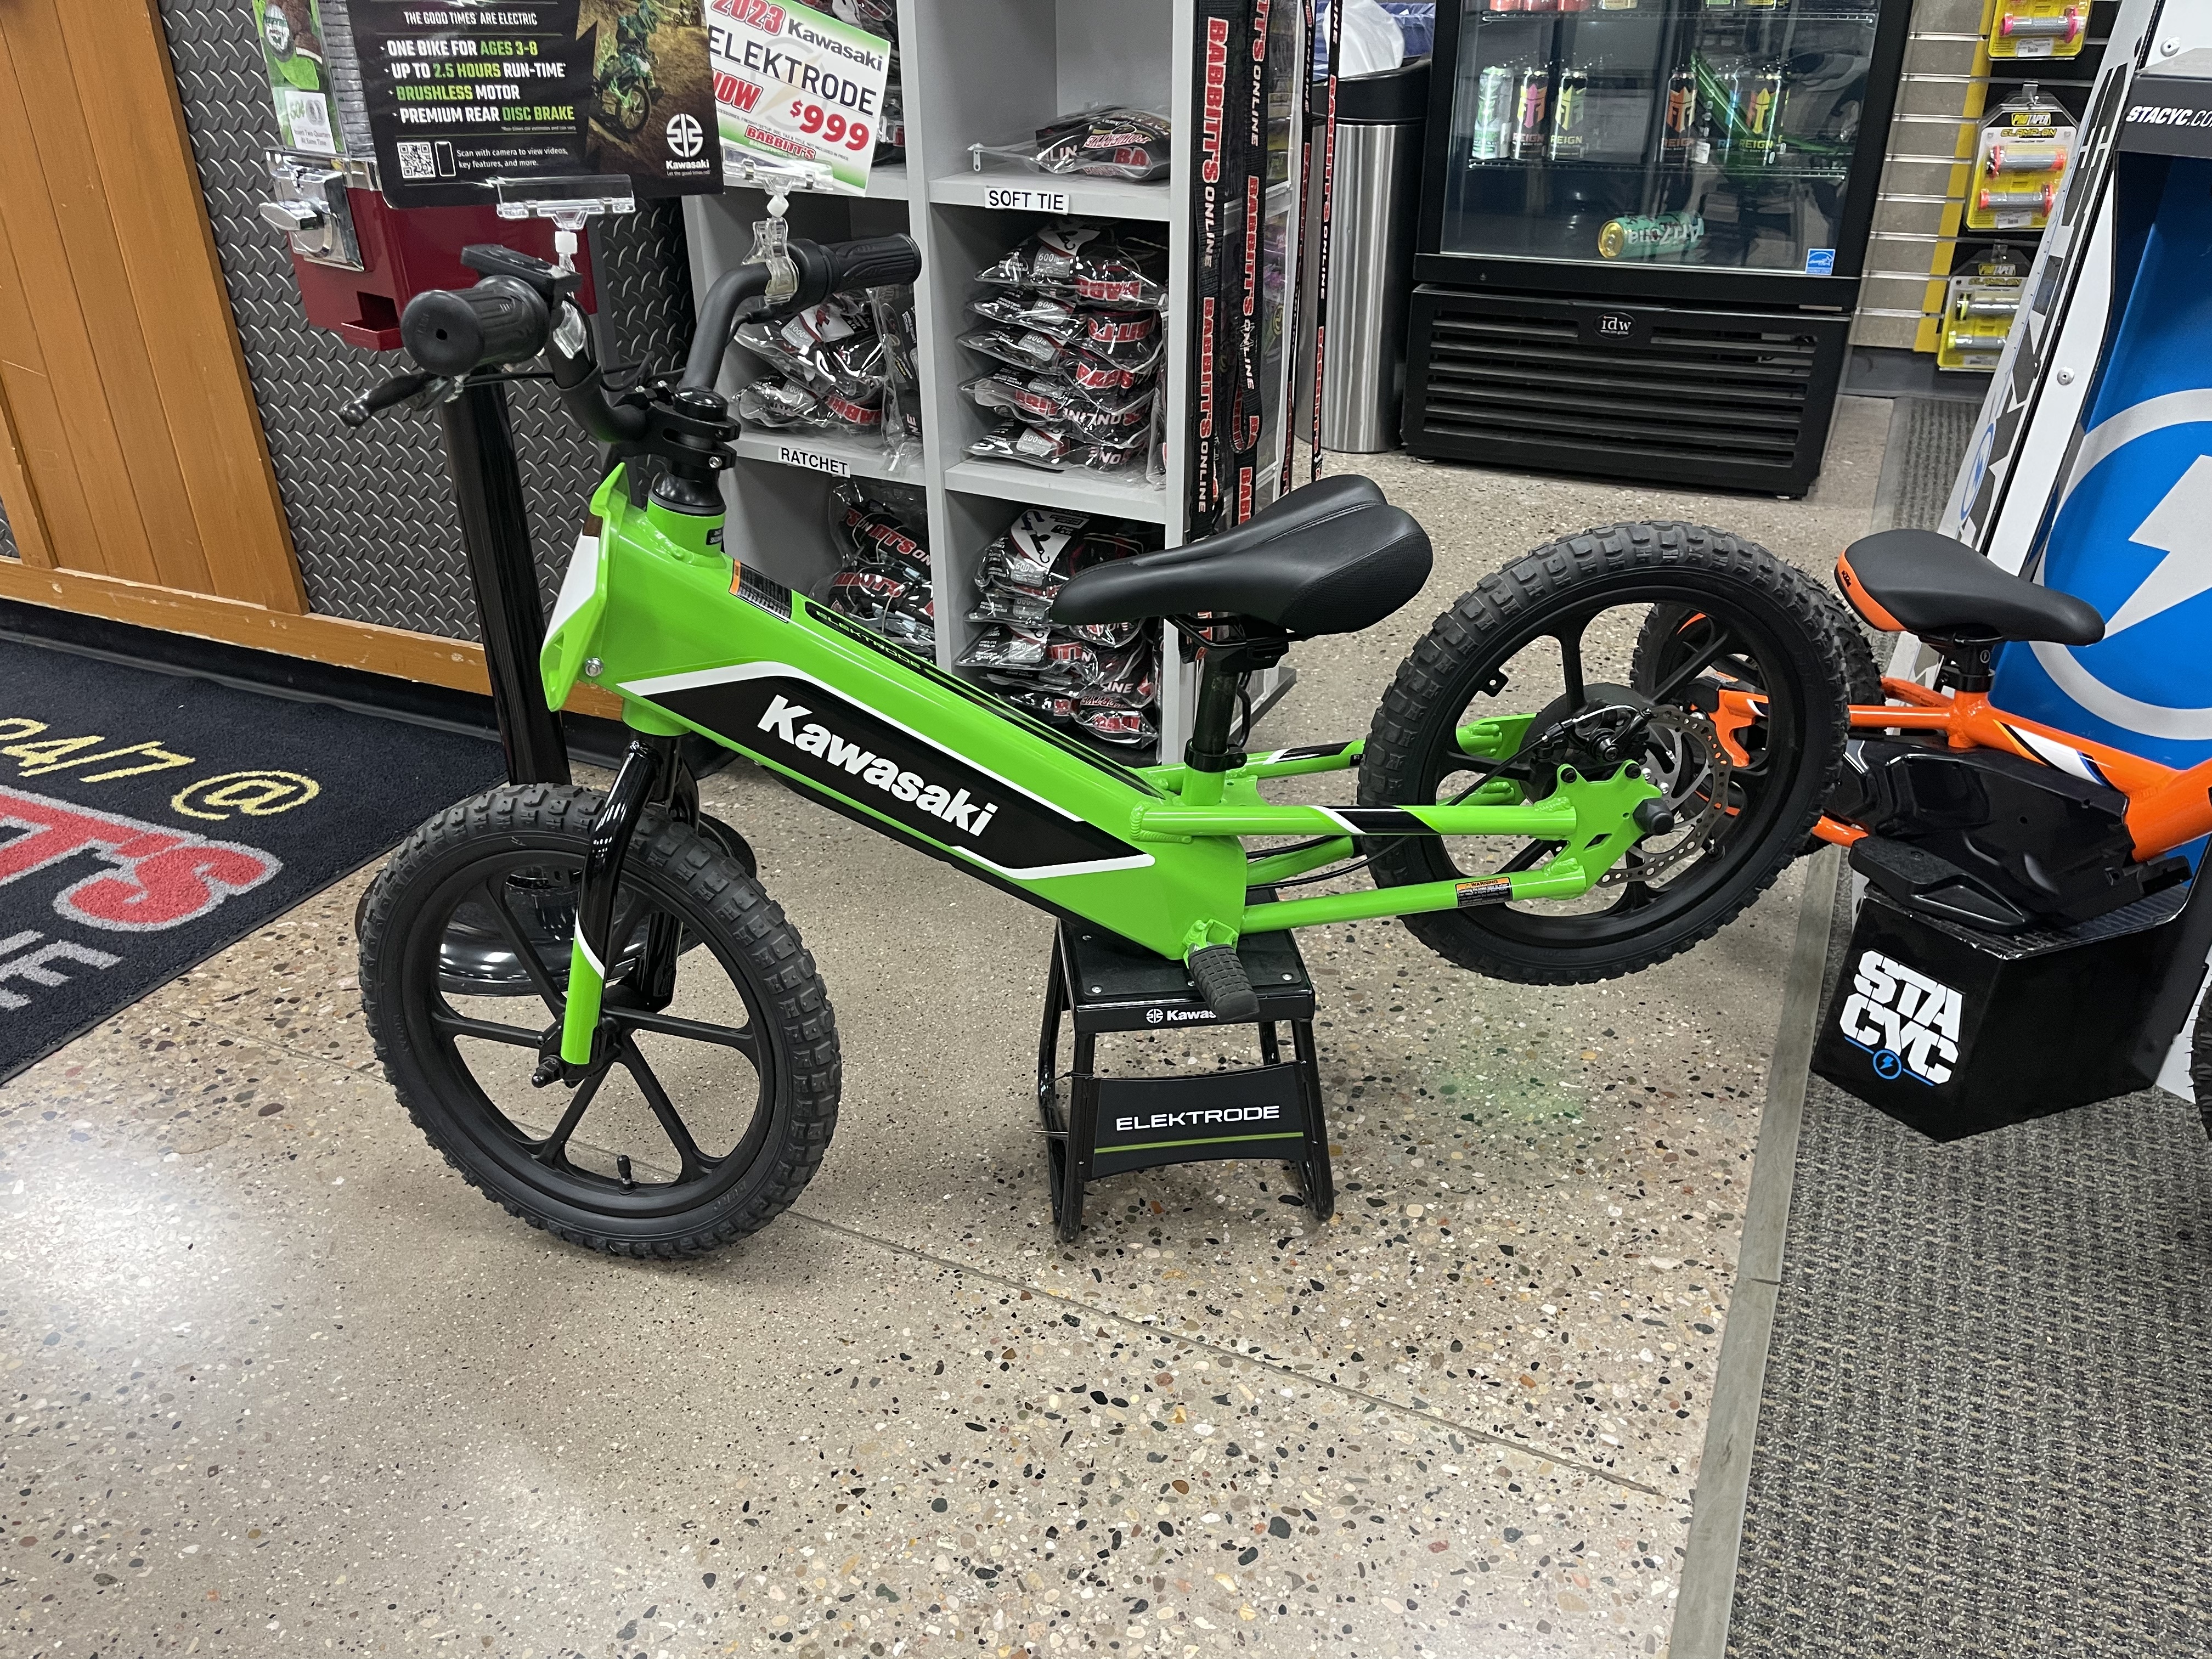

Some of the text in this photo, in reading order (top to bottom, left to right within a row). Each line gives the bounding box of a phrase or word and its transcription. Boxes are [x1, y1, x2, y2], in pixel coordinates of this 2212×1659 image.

[404, 12, 422, 24] THE
[424, 12, 448, 24] GOOD
[481, 12, 496, 25] ARE
[499, 13, 538, 25] ELECTRIC
[387, 40, 539, 56] ONE BIKE FOR AGES 3-8
[788, 18, 883, 72] Kawasaki
[391, 63, 410, 78] UP
[411, 63, 431, 78] TO
[433, 63, 454, 78] 2.5
[457, 63, 501, 78] HOURS
[708, 24, 877, 116] ELEKTRODE
[396, 85, 520, 101] BRUSHLESS MOTOR
[399, 106, 575, 123] PREMIUM REAR DISC BRAKE
[1251, 65, 1261, 147] ONLINE
[2126, 106, 2212, 127] STACYC.CO
[790, 99, 870, 151] $999
[744, 125, 816, 160] BABBITT'S
[1203, 16, 1229, 268] BABBITT'S ONLINE
[1550, 136, 1583, 144] REIGN
[1739, 140, 1773, 149] REIGN
[476, 149, 491, 157] with
[544, 146, 568, 155] videos,
[459, 160, 471, 170] key
[473, 160, 503, 168] features,
[666, 159, 709, 170] Kawasaki
[989, 189, 1064, 211] SOFT TIE
[1243, 175, 1259, 316] BABBITT'S
[1601, 315, 1632, 330] idw
[1026, 334, 1047, 346] 600lb
[1198, 297, 1215, 513] BABBITT'S ONLINE
[1023, 435, 1043, 444] 600lb
[781, 447, 848, 476] RATCHET
[1015, 562, 1035, 573] 600lb
[816, 611, 921, 669] ELEKTRODE
[757, 695, 998, 837] Kawasaki
[171, 769, 322, 821] @
[1853, 950, 1962, 1042] STA
[1167, 1009, 1217, 1022] Kawas
[1839, 993, 1960, 1084] CYC
[1116, 1105, 1280, 1131] ELEKTRODE
